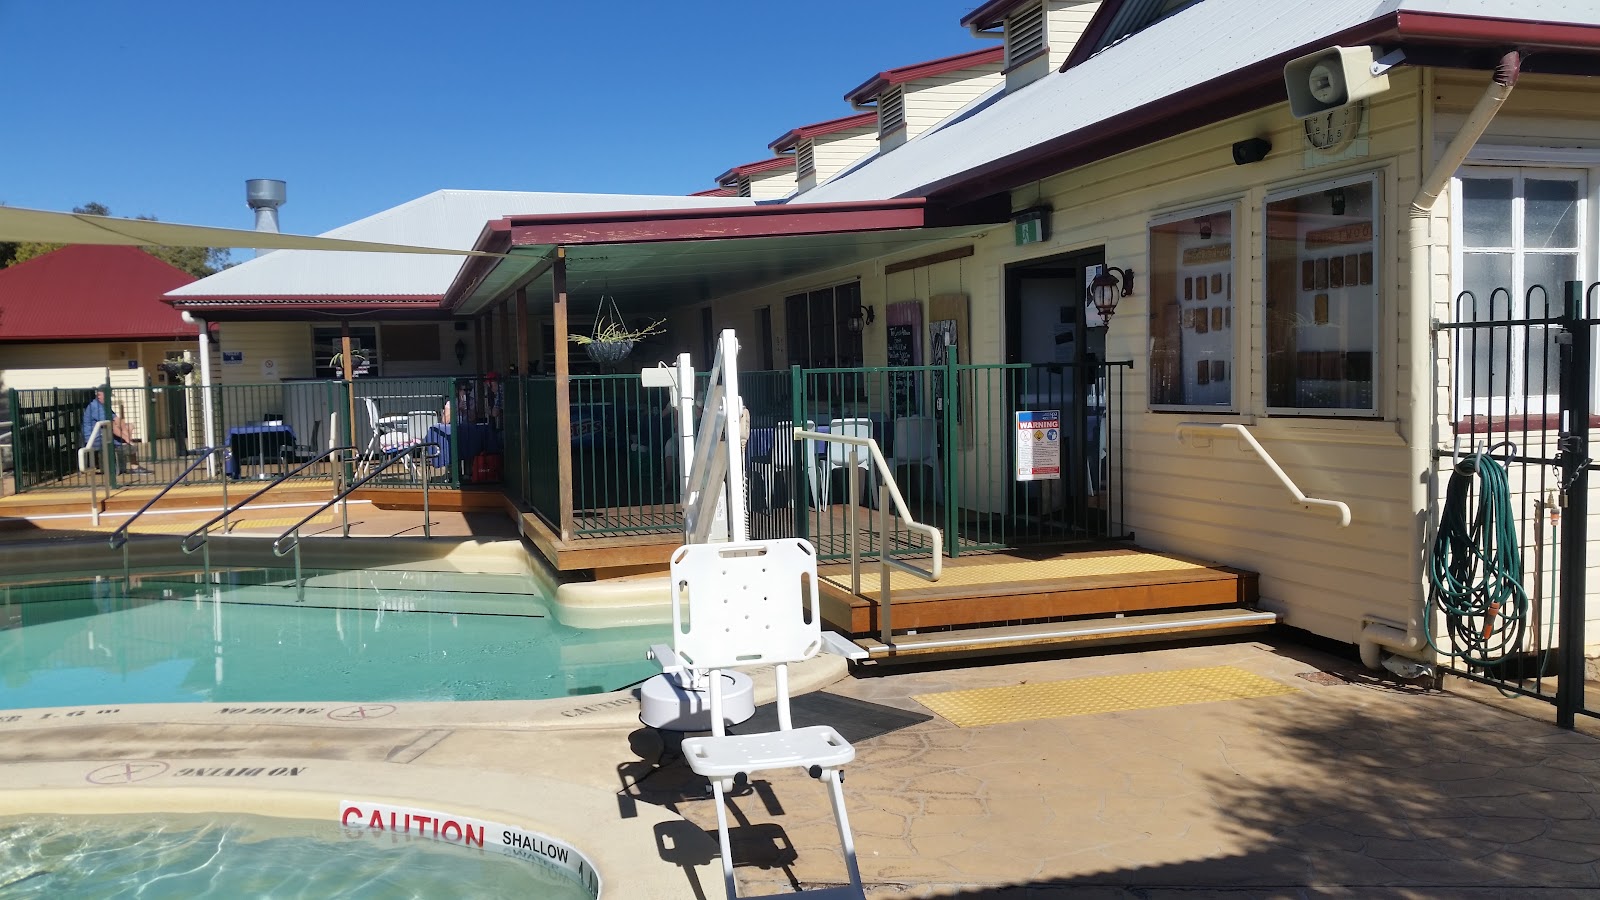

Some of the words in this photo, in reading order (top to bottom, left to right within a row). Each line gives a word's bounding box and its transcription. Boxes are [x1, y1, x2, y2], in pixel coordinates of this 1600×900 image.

[1019, 421, 1059, 429] WARNING
[213, 707, 247, 715] NO
[244, 707, 325, 715] DIVING
[172, 766, 265, 777] DIVING
[266, 766, 308, 777] NO
[341, 806, 485, 849] CAUTION
[502, 830, 569, 864] SHALLOW
